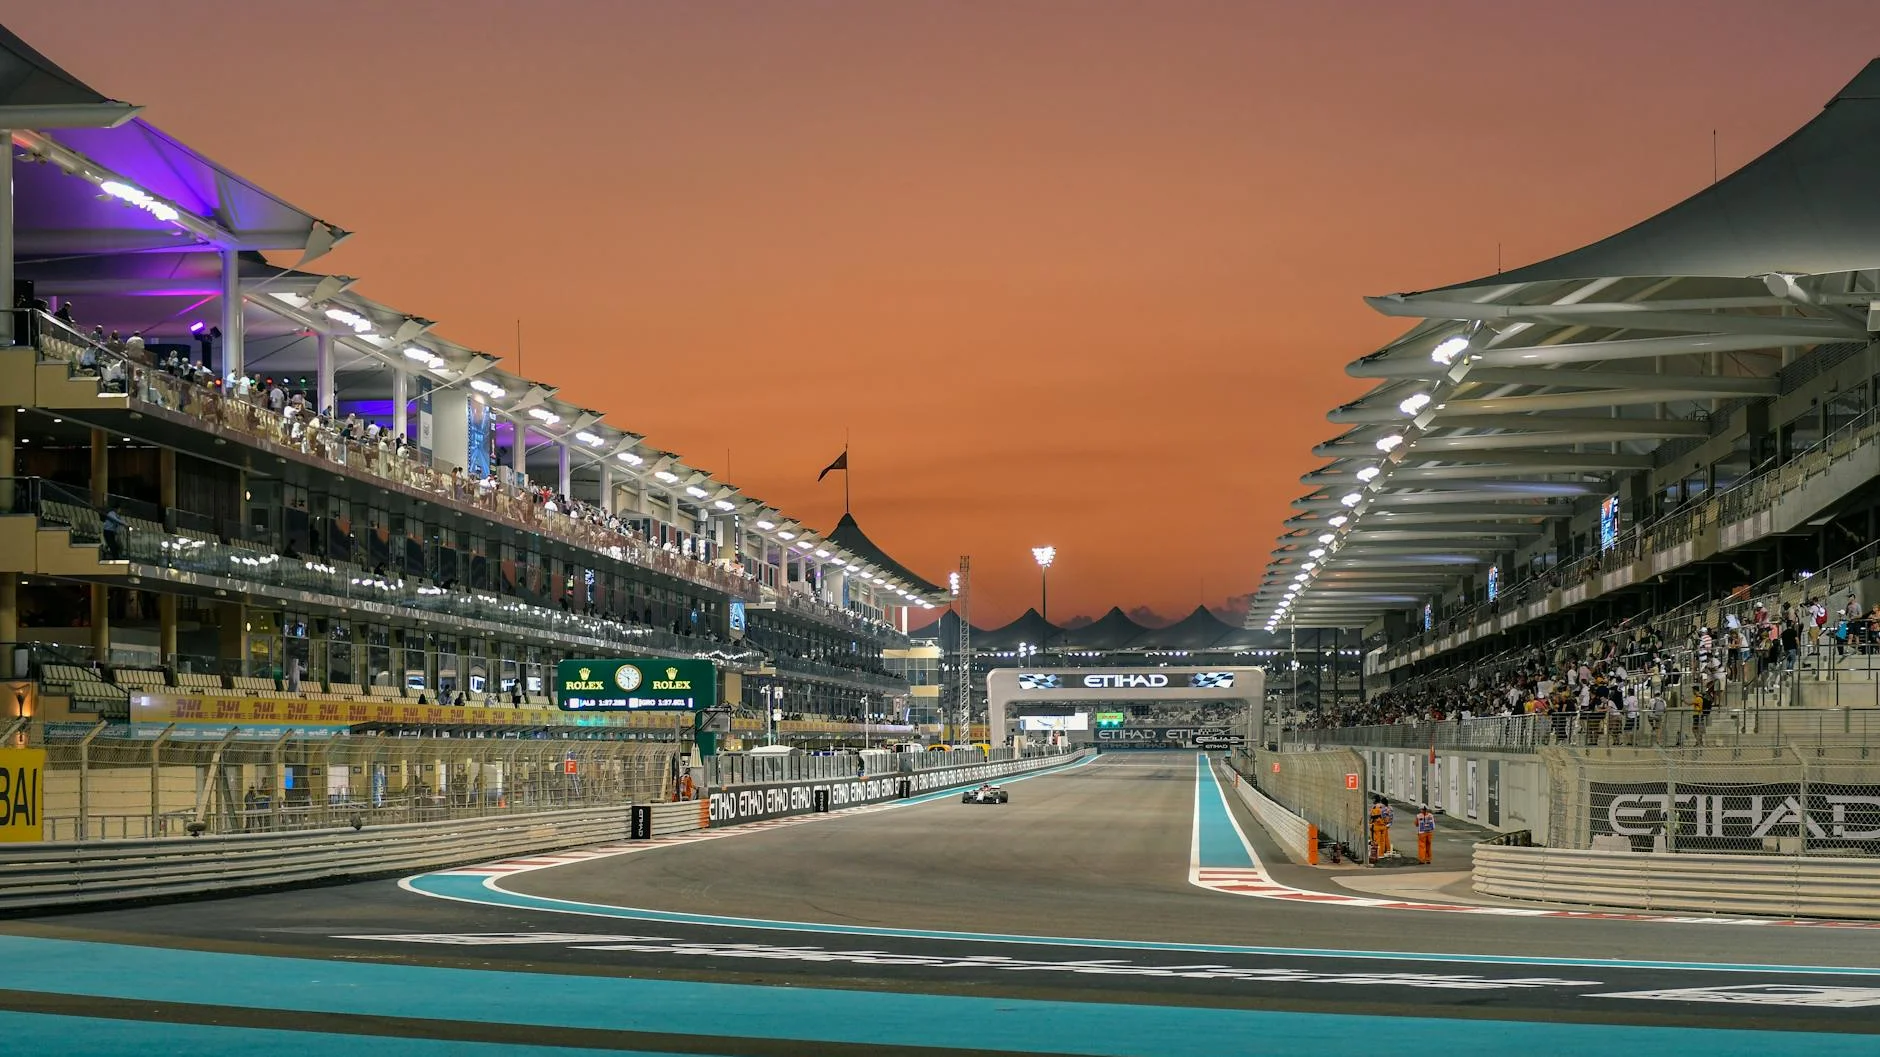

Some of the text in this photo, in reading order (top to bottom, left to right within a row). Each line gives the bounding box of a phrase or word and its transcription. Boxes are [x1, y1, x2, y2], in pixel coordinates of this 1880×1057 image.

[565, 681, 604, 690] ROLEX
[653, 680, 691, 690] ROLEX
[1083, 674, 1168, 688] ETIHAD
[176, 699, 204, 718] DHL
[216, 700, 242, 719] DHL
[253, 701, 277, 719] DHL
[287, 702, 309, 720] DHL
[319, 704, 340, 720] DHL
[349, 705, 367, 721] DHL
[1098, 729, 1156, 739] ETIHAD
[1348, 776, 1355, 788] F
[709, 793, 736, 820] ETIHAD
[740, 790, 764, 816] ETIHAD
[766, 788, 788, 812] ETIHAD
[791, 786, 810, 809] ETIHAD
[833, 783, 849, 804] ETIHAD
[1608, 794, 1880, 838] ETIHAD
